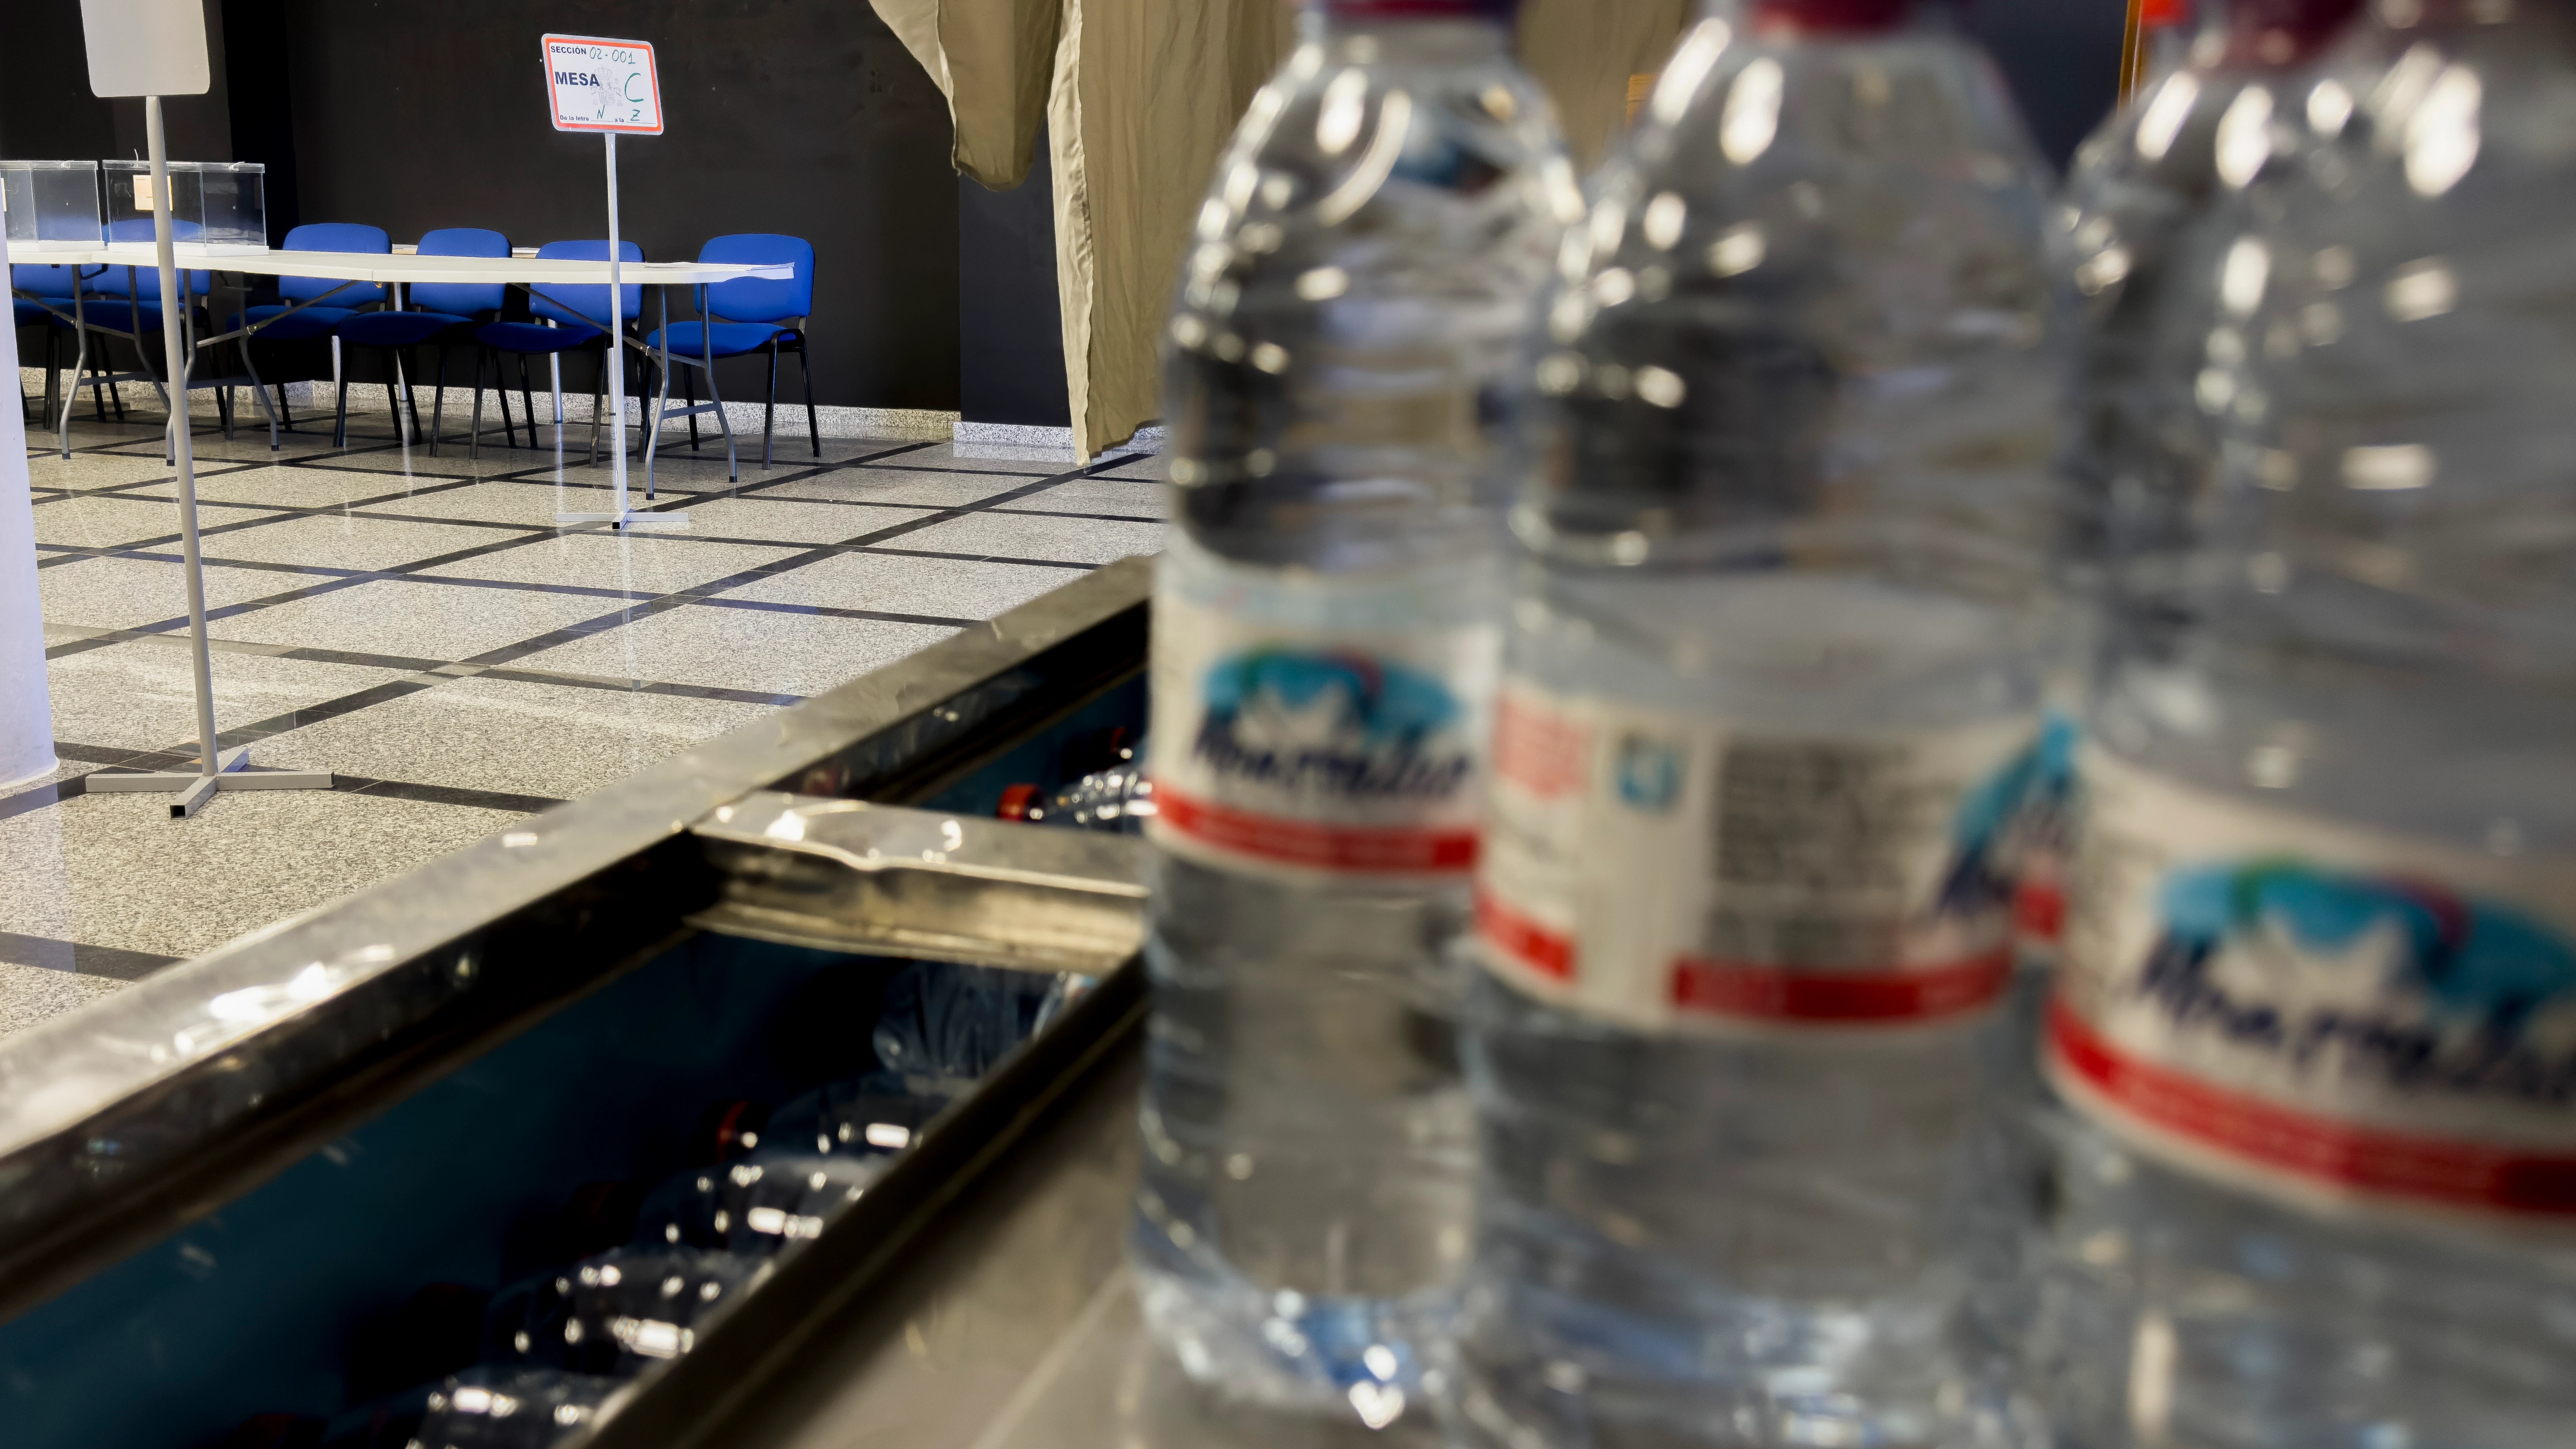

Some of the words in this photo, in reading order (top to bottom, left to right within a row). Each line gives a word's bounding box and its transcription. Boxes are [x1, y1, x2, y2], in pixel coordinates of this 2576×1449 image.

[551, 46, 587, 54] SECCIÓN
[555, 71, 600, 86] MESA
[625, 73, 644, 102] C
[597, 104, 605, 119] N
[630, 109, 640, 121] Z
